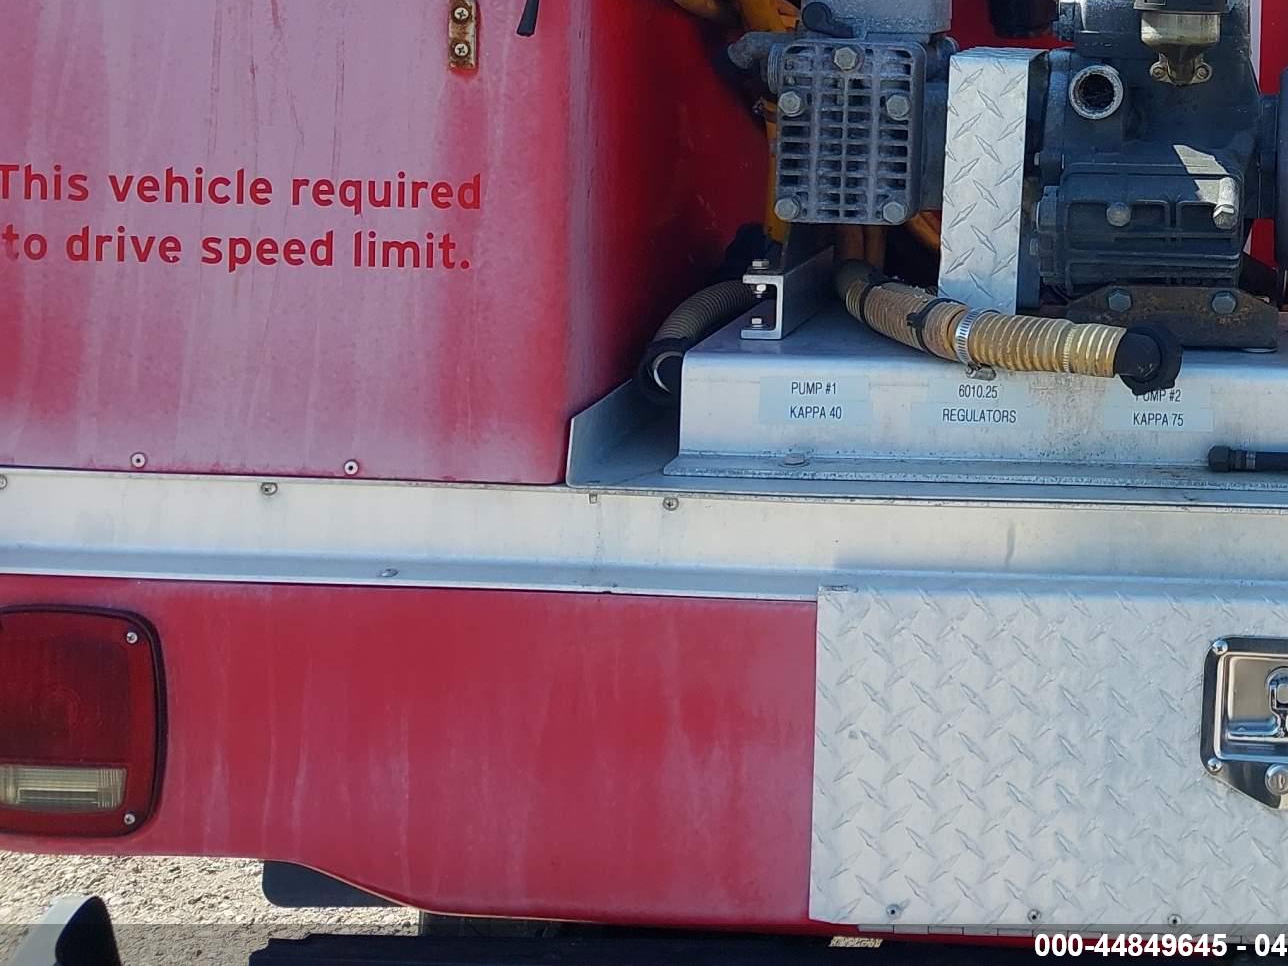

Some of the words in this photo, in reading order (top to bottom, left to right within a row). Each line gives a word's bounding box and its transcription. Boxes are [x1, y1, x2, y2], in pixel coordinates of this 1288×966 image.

[0, 163, 89, 202] This
[108, 165, 273, 206] vehicle
[291, 172, 482, 216] required
[1, 223, 48, 262] to
[65, 224, 182, 263] drive
[200, 230, 334, 274] speed
[352, 230, 471, 270] limit.
[791, 381, 823, 395] PUMP
[825, 382, 837, 395] #1
[958, 384, 998, 399] 6010.25
[1169, 389, 1182, 402] #2
[789, 405, 827, 419] KAPPA
[829, 405, 843, 420] 40
[942, 408, 1017, 424] REGULATORS
[1132, 412, 1169, 426] KAPPA
[1171, 413, 1184, 427] 75
